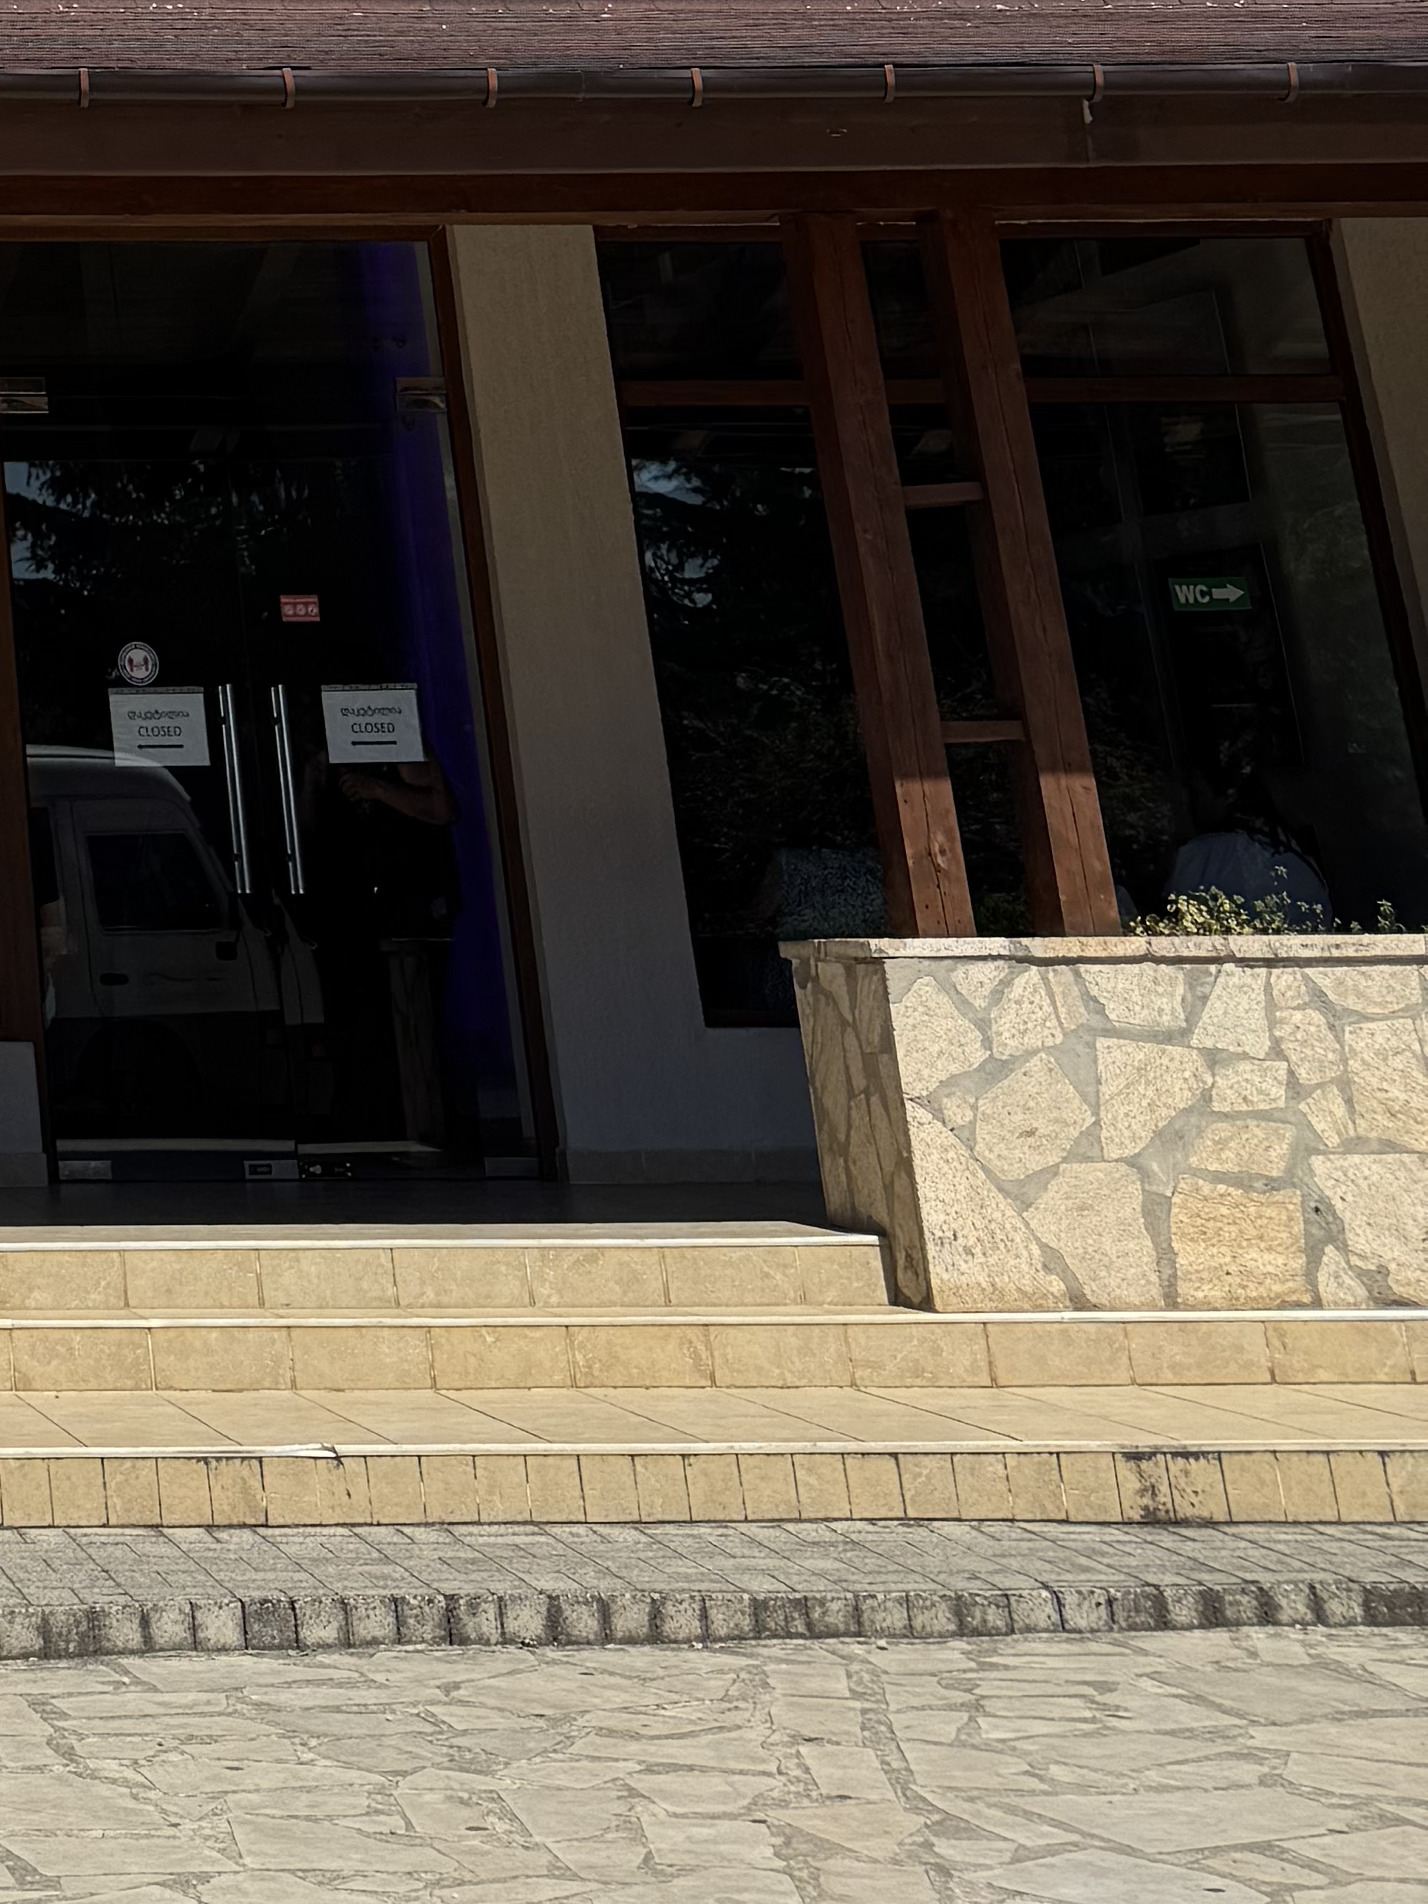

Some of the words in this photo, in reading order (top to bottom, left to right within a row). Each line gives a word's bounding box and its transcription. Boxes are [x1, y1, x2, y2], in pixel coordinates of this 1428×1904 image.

[1174, 584, 1211, 604] WC
[137, 725, 182, 737] CLOSED
[350, 721, 396, 734] CLOSED
